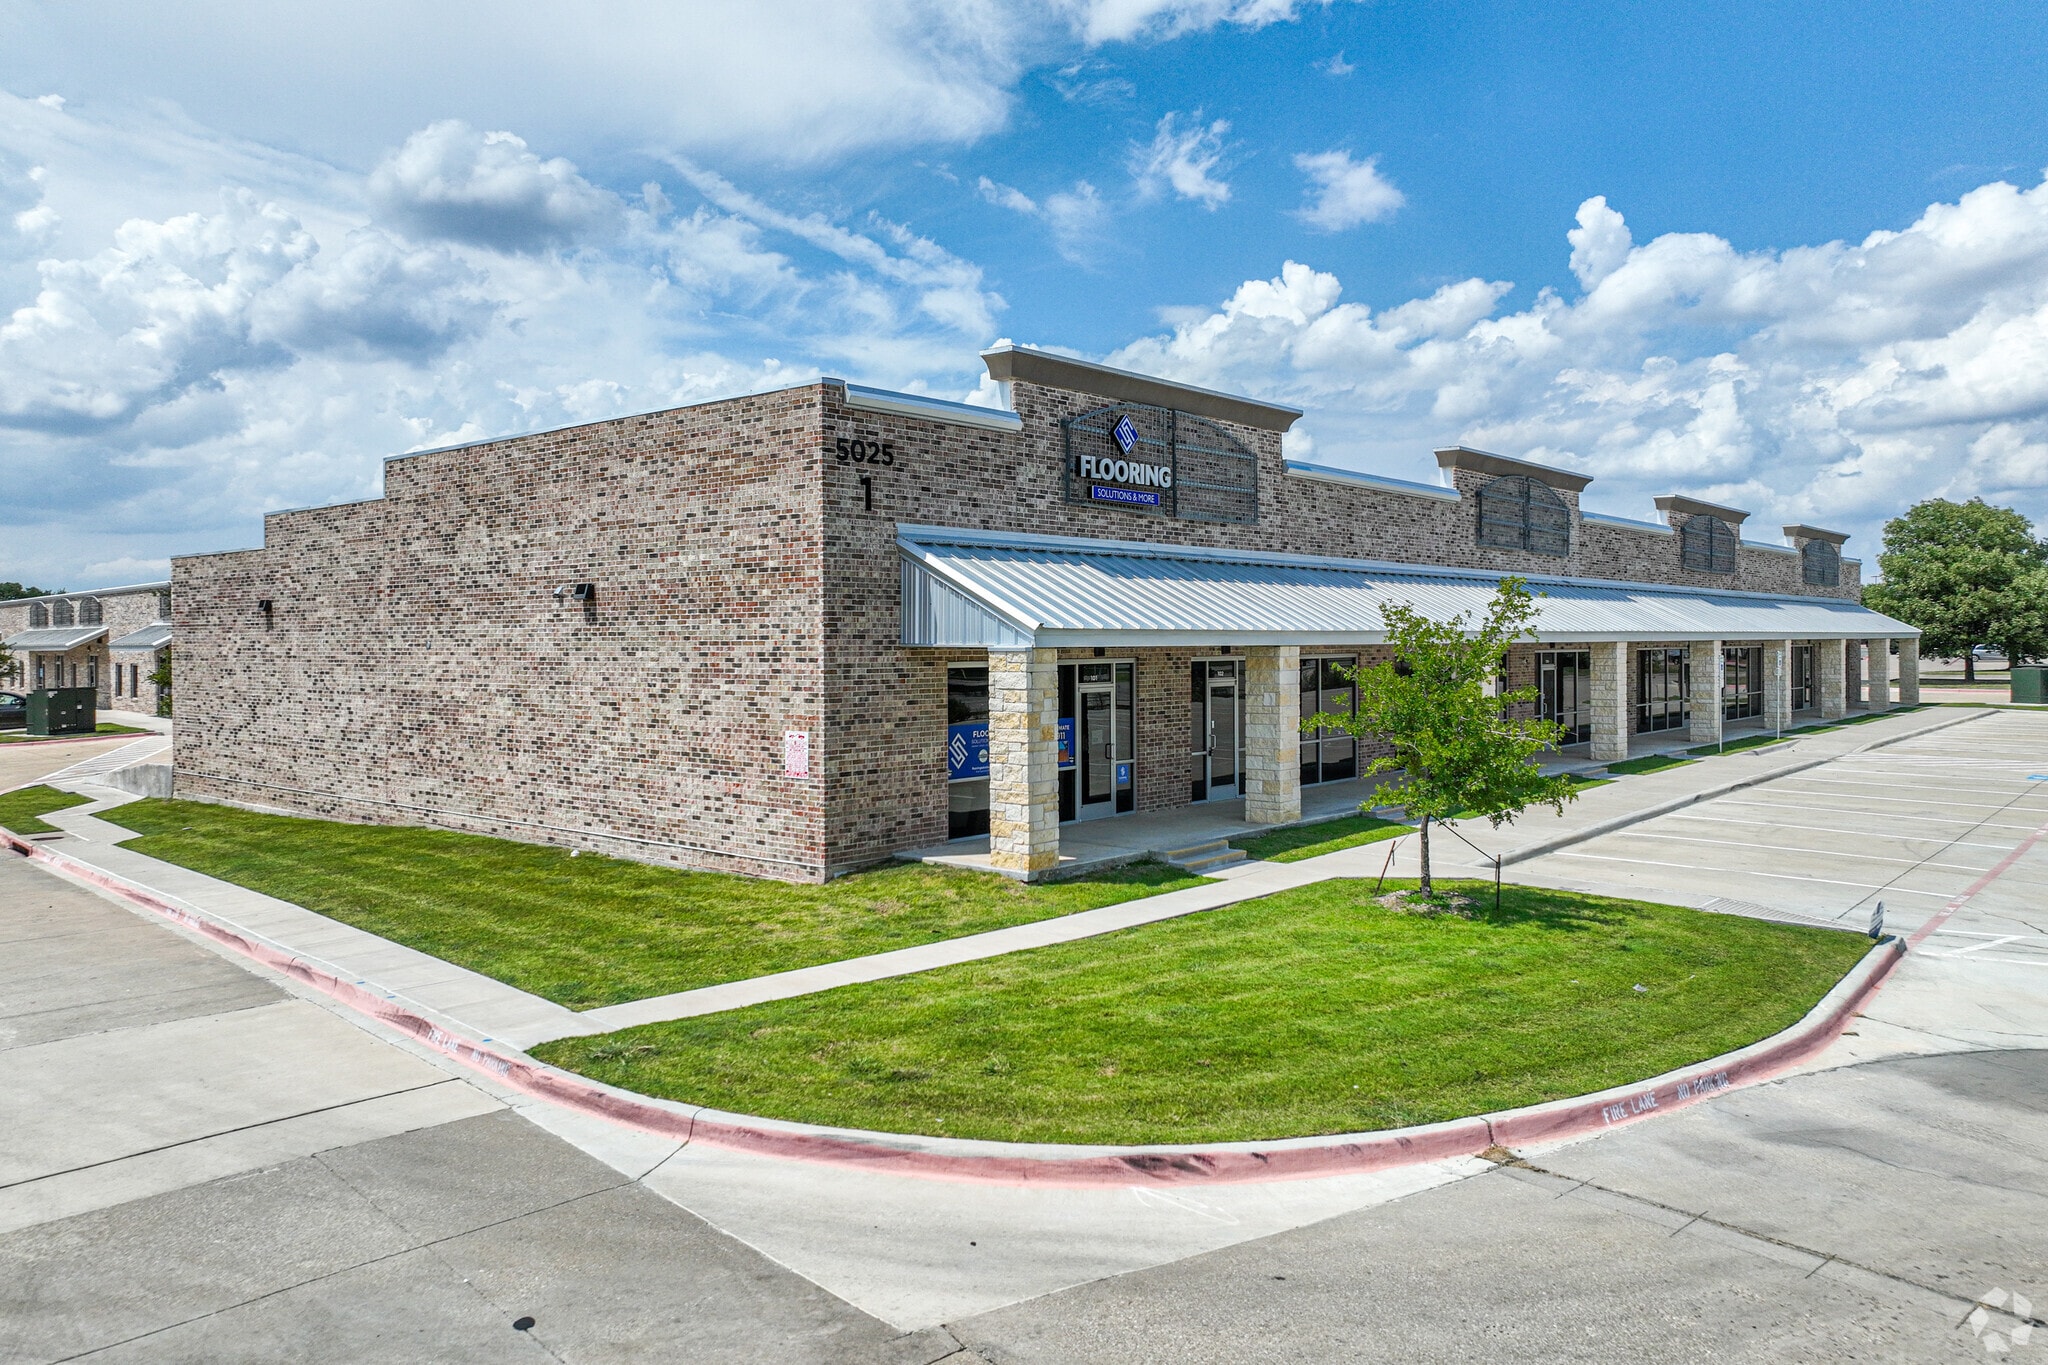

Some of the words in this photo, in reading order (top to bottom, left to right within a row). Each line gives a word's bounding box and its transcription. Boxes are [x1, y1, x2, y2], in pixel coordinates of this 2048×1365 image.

[836, 438, 894, 466] 5025
[1080, 455, 1171, 488] FLOORING
[860, 477, 872, 511] 1
[1097, 488, 1132, 502] SOLUTIONS
[1132, 494, 1138, 502] &
[1138, 493, 1155, 503] MORE
[1602, 1102, 1628, 1124] FIRE
[1630, 1092, 1658, 1114] LANE
[1676, 1083, 1690, 1100] NO
[1693, 1072, 1729, 1094] PARKING
